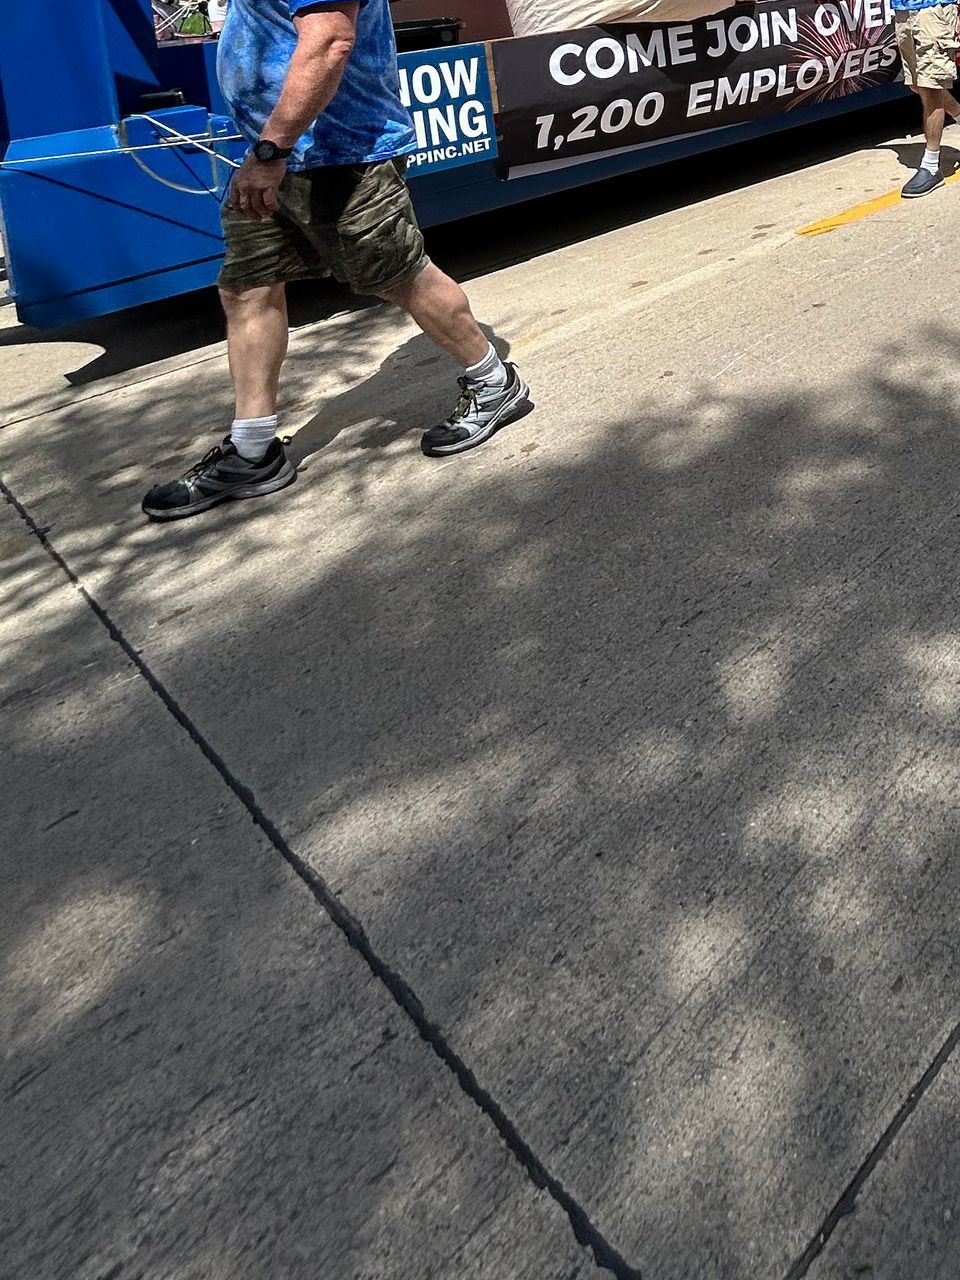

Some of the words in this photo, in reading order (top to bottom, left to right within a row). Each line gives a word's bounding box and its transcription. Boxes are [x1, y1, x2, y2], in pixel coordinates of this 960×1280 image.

[549, 24, 697, 86] COME
[706, 7, 799, 58] JOIN
[535, 91, 665, 151] 1,200
[686, 41, 898, 118] EMPLOYEES
